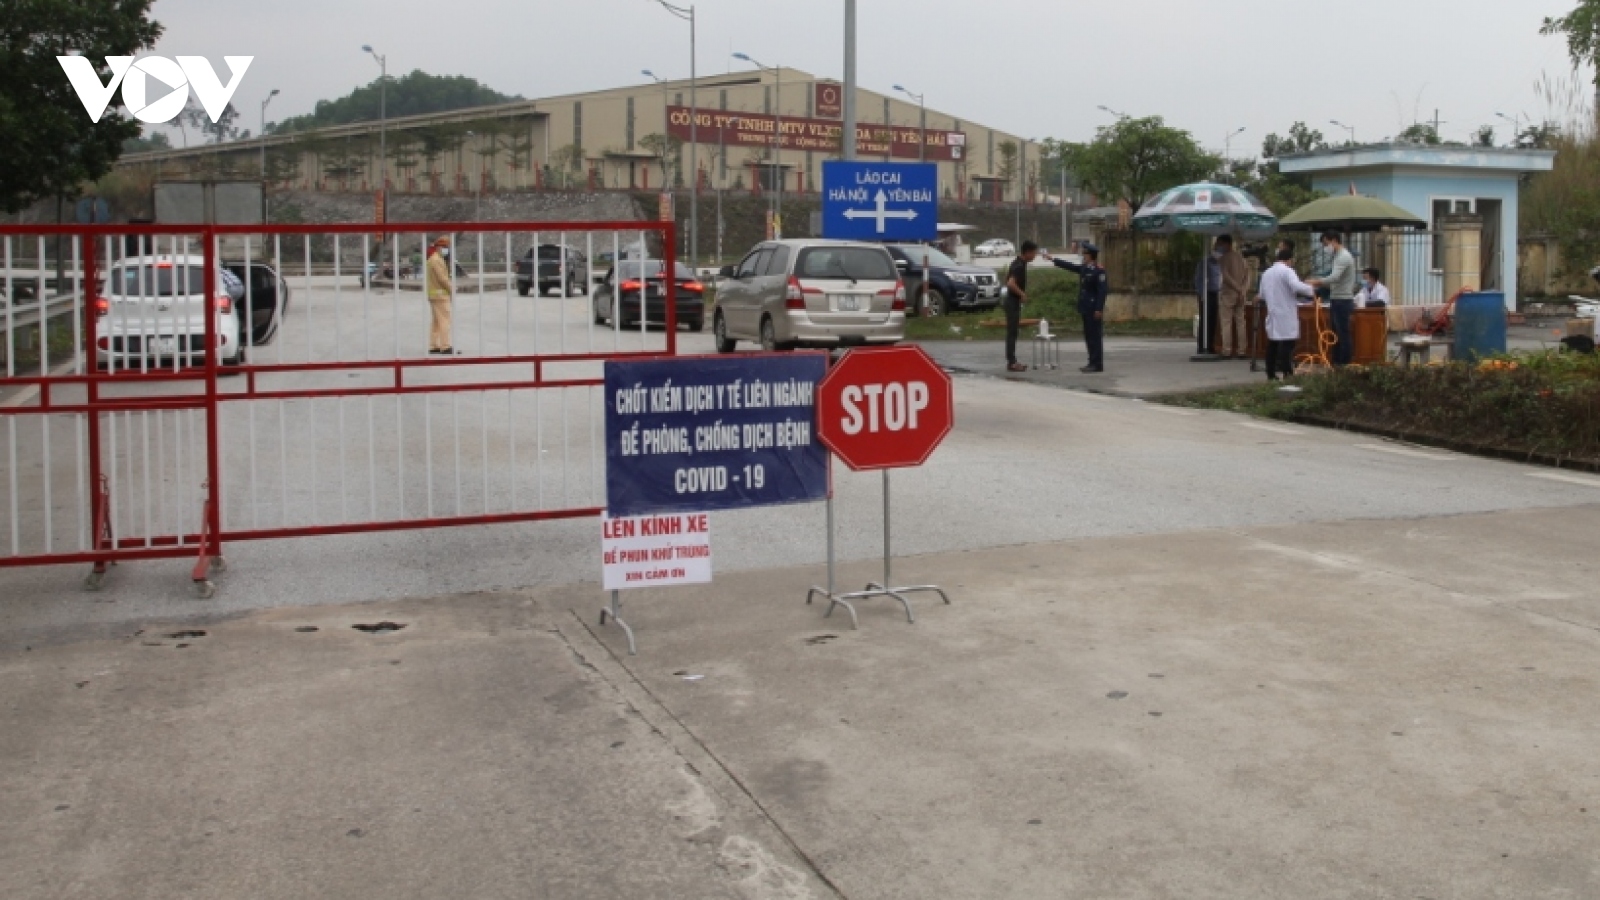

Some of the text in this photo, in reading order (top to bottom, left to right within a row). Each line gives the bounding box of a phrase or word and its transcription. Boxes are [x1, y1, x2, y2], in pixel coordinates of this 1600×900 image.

[670, 109, 711, 127] CÔNG
[714, 115, 733, 130] TY
[736, 118, 775, 132] TNHH
[778, 121, 806, 134] MTV
[855, 128, 871, 139] OA
[881, 171, 901, 184] CAI
[828, 186, 869, 204] HÀ NỘI
[888, 187, 911, 202] YÊN
[615, 377, 814, 415] CHỐT KIỂM DỊCH Y TẾ LIÊN NGÀNH
[841, 380, 930, 435] STOP
[695, 419, 740, 451] CHỐNG
[743, 422, 774, 453] DỊCH
[776, 417, 811, 450] BỆNH
[675, 465, 727, 494] COVID
[743, 464, 765, 489] 19
[603, 514, 709, 539] LÊN KÍNH XE
[620, 549, 648, 563] PHUN
[651, 542, 674, 560] KHỬ
[625, 571, 643, 581] XIN
